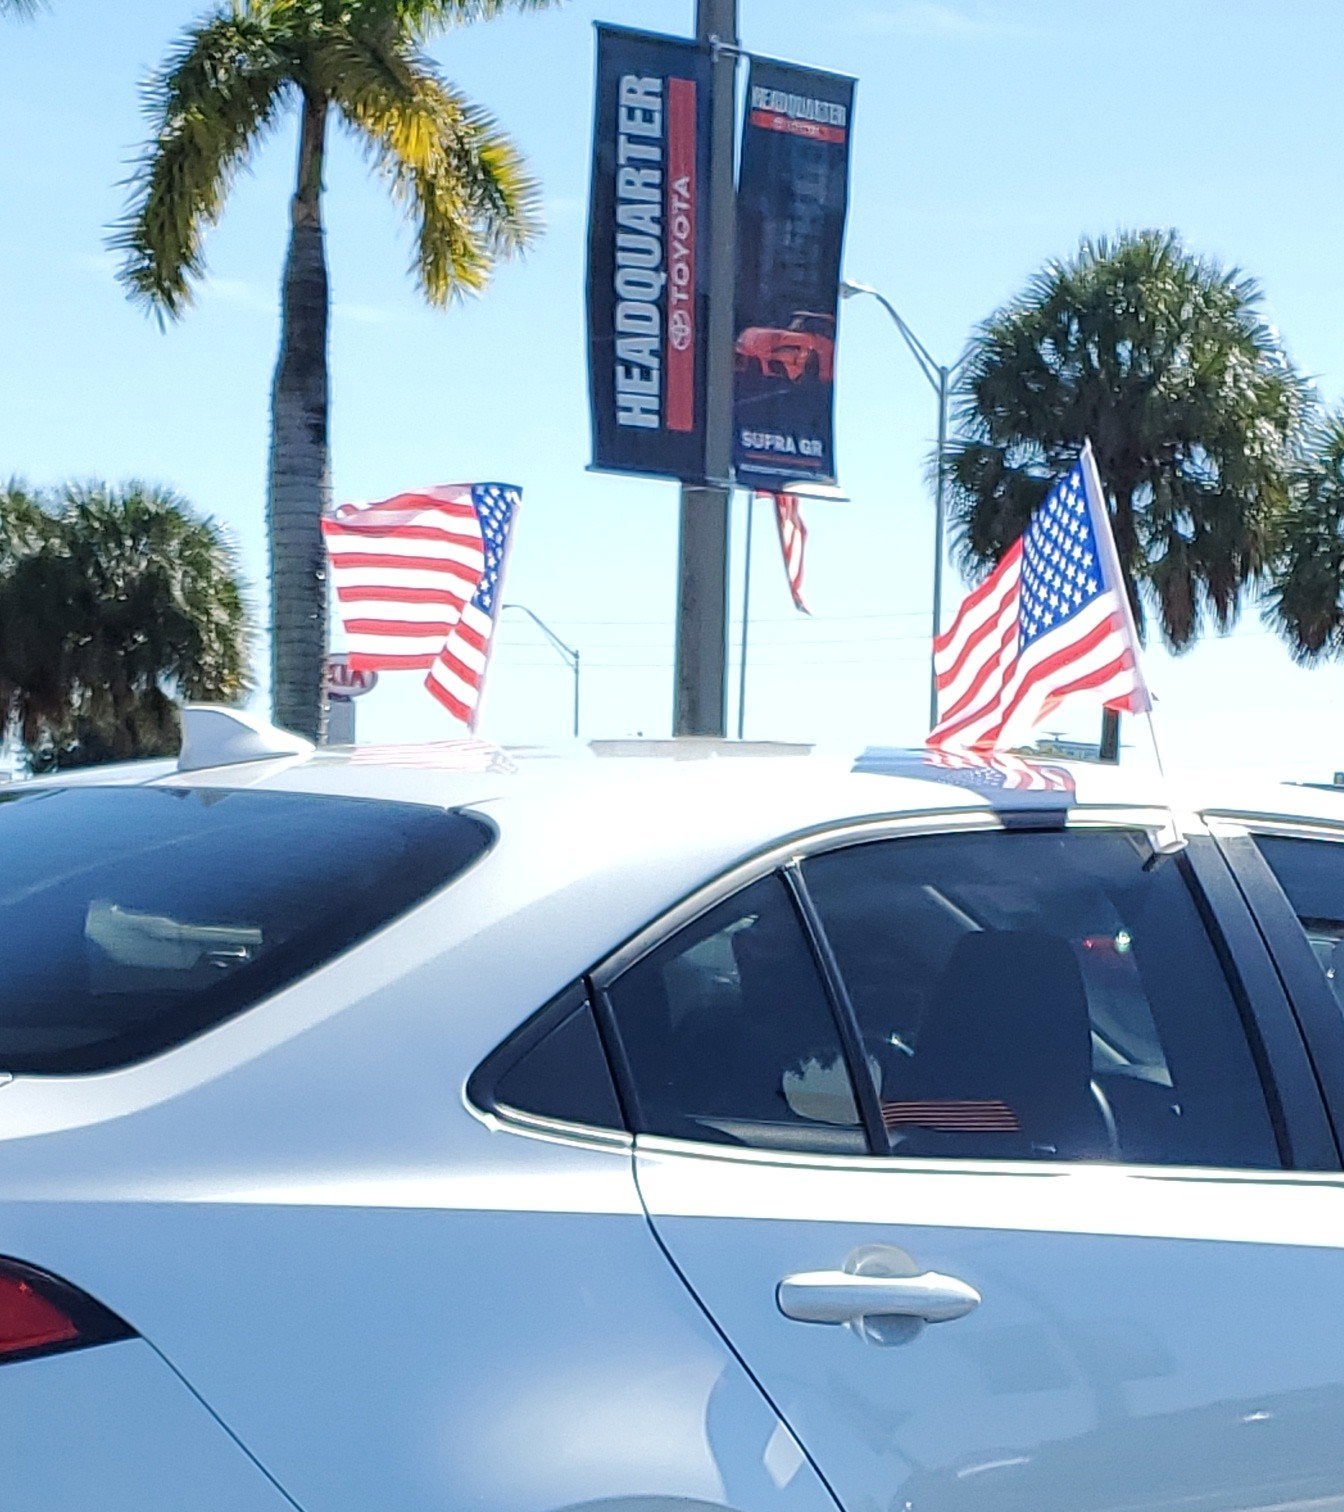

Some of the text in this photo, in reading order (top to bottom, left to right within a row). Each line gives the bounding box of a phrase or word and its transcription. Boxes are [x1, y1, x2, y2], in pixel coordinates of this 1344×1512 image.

[614, 74, 667, 430] HEADQUARTER
[671, 175, 691, 305] TOYOTA
[741, 430, 823, 457] SUPRA GR
